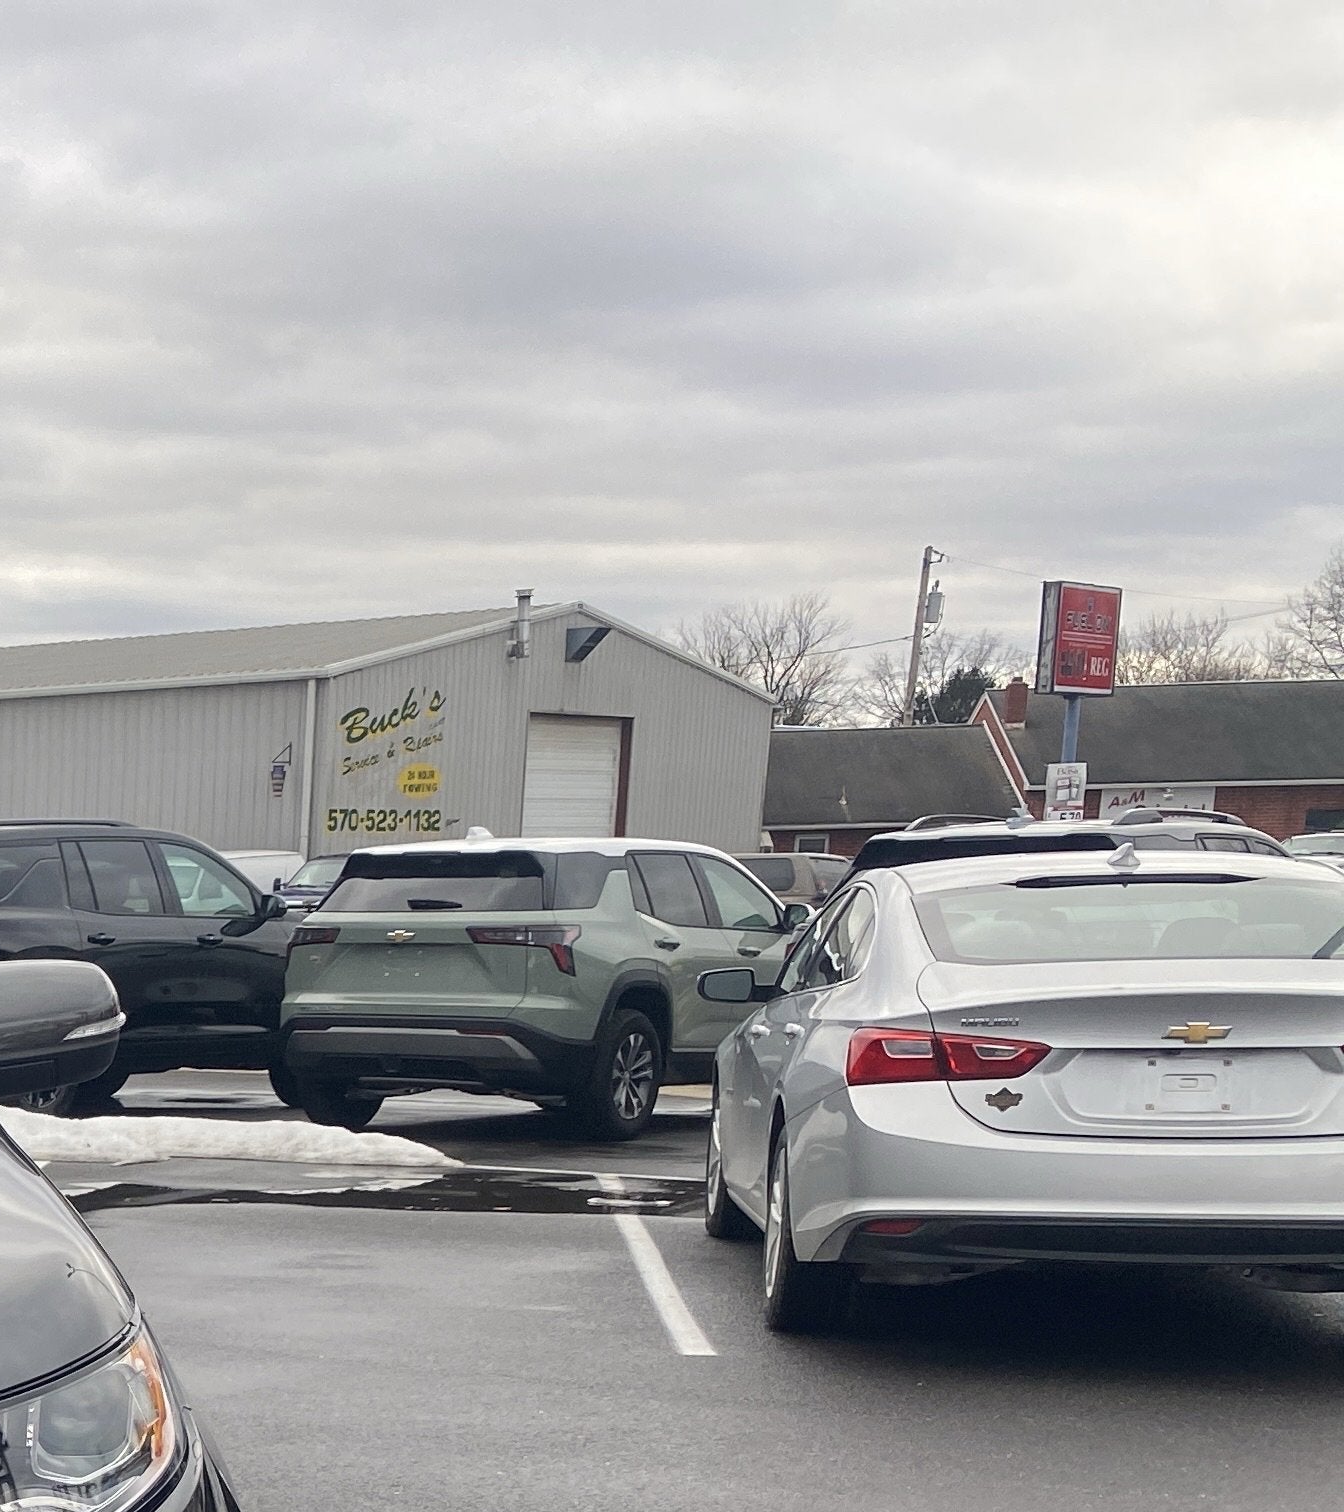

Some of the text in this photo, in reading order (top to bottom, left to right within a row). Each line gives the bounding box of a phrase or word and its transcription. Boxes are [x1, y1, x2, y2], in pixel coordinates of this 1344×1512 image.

[1089, 656, 1109, 676] REG
[339, 686, 446, 744] Buck's
[402, 783, 438, 793] TOWING
[961, 1018, 1019, 1027] MALIBU
